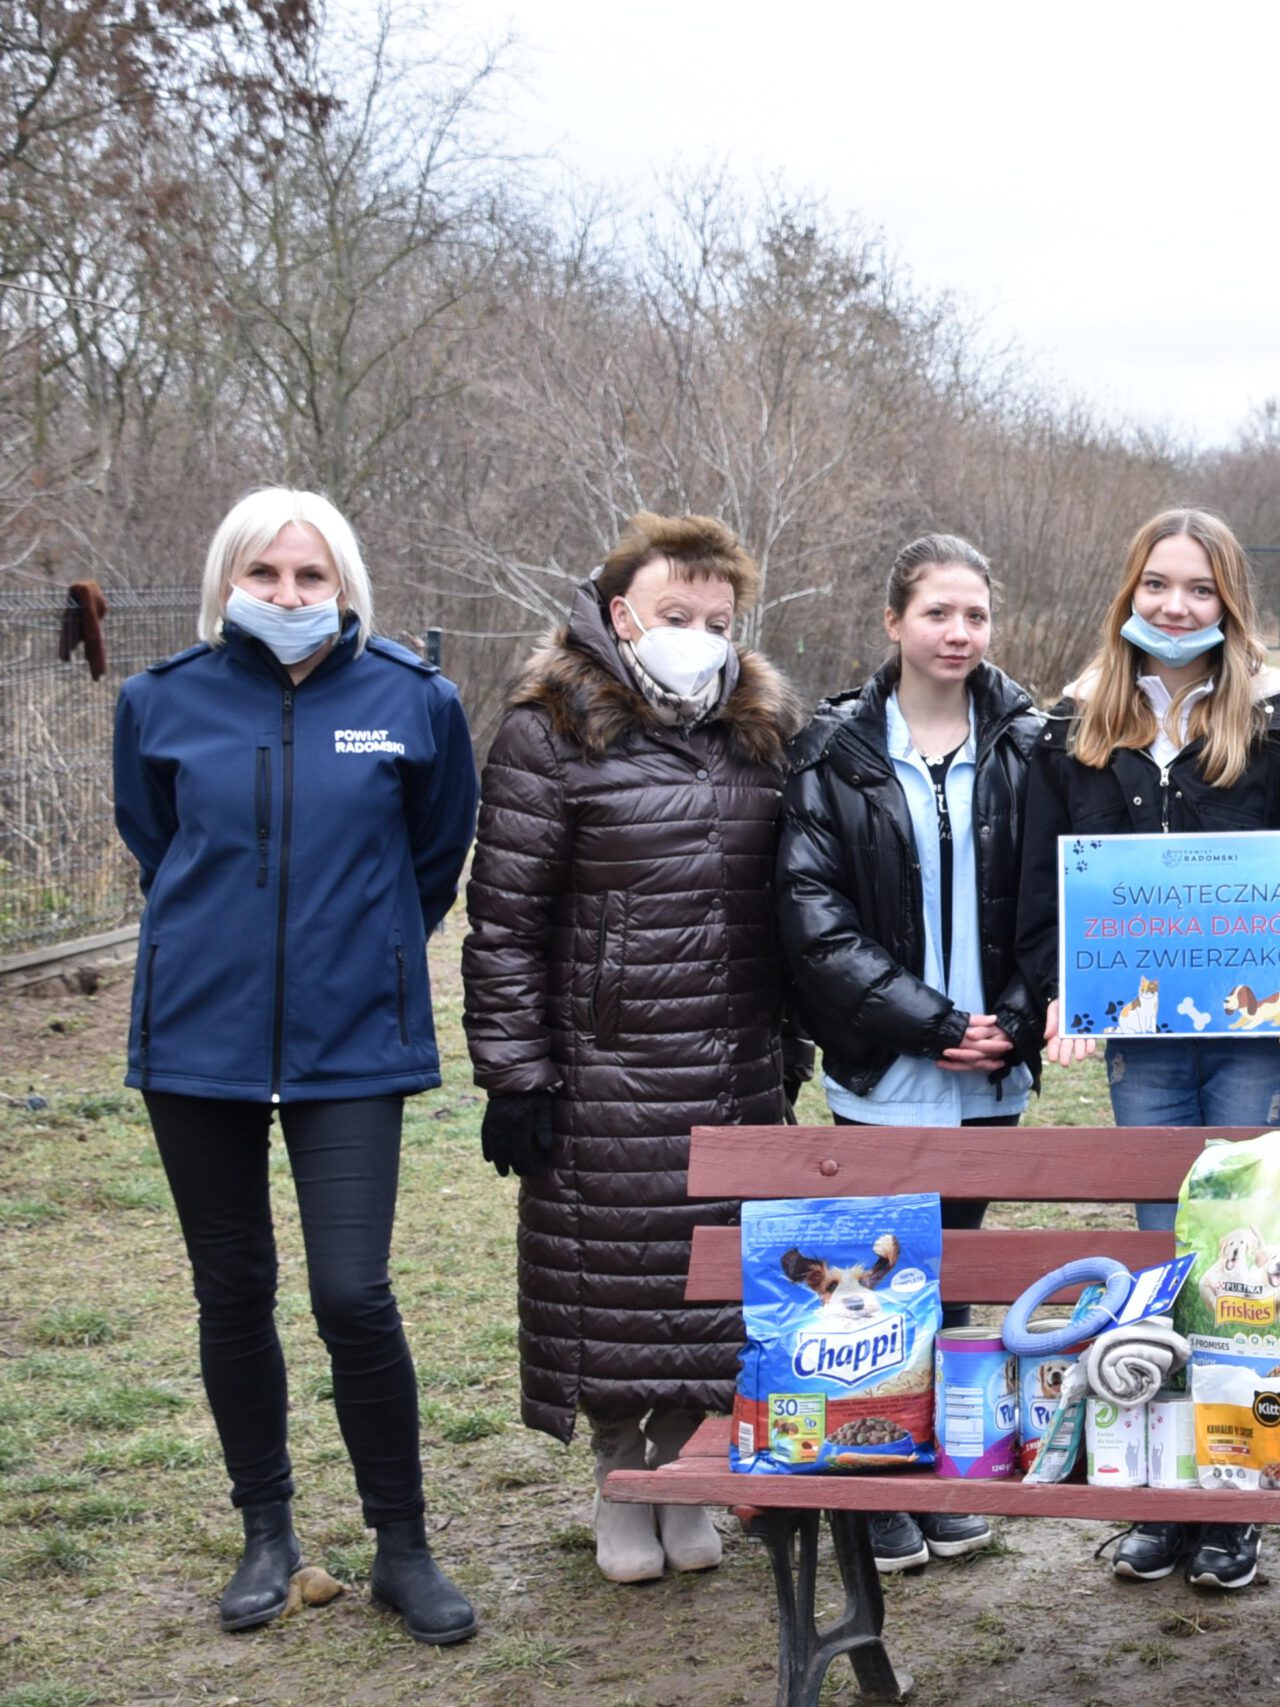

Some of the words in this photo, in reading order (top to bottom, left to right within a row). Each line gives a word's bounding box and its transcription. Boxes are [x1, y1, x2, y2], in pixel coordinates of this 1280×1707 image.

[334, 729, 389, 742] POWIAT
[335, 741, 405, 755] RADOMSKI
[1083, 912, 1203, 938] ZBIÓRKA
[1076, 950, 1128, 969] DLA
[1226, 1282, 1262, 1294] PURINA
[794, 1323, 899, 1377] Chappi
[1195, 1340, 1230, 1351] PROMISES
[773, 1398, 798, 1417] 30
